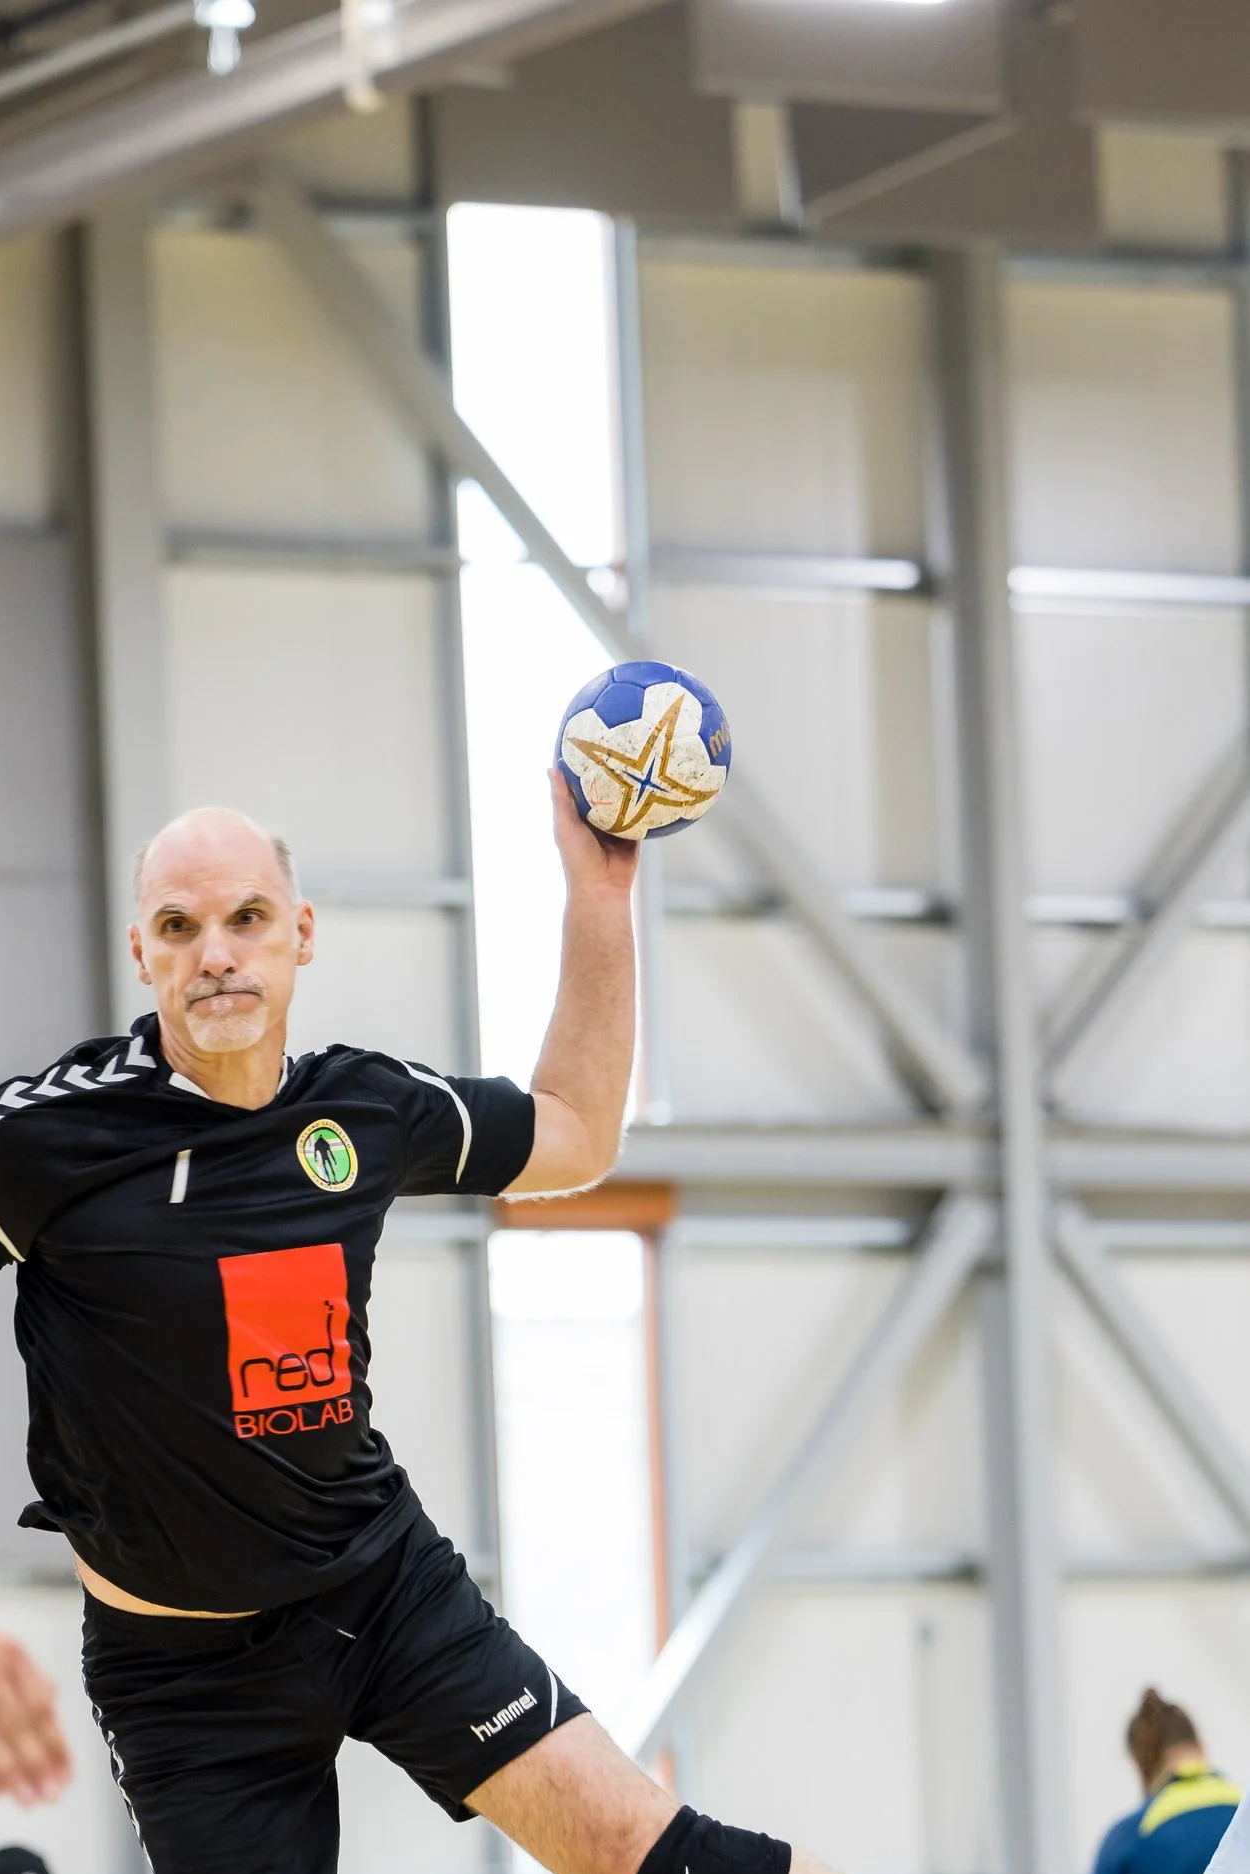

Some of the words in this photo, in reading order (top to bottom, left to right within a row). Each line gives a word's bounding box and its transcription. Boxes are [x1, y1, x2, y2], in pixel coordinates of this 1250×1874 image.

[240, 1300, 336, 1398] red
[234, 1398, 355, 1439] BIOLAB
[469, 1686, 538, 1742] hummel
